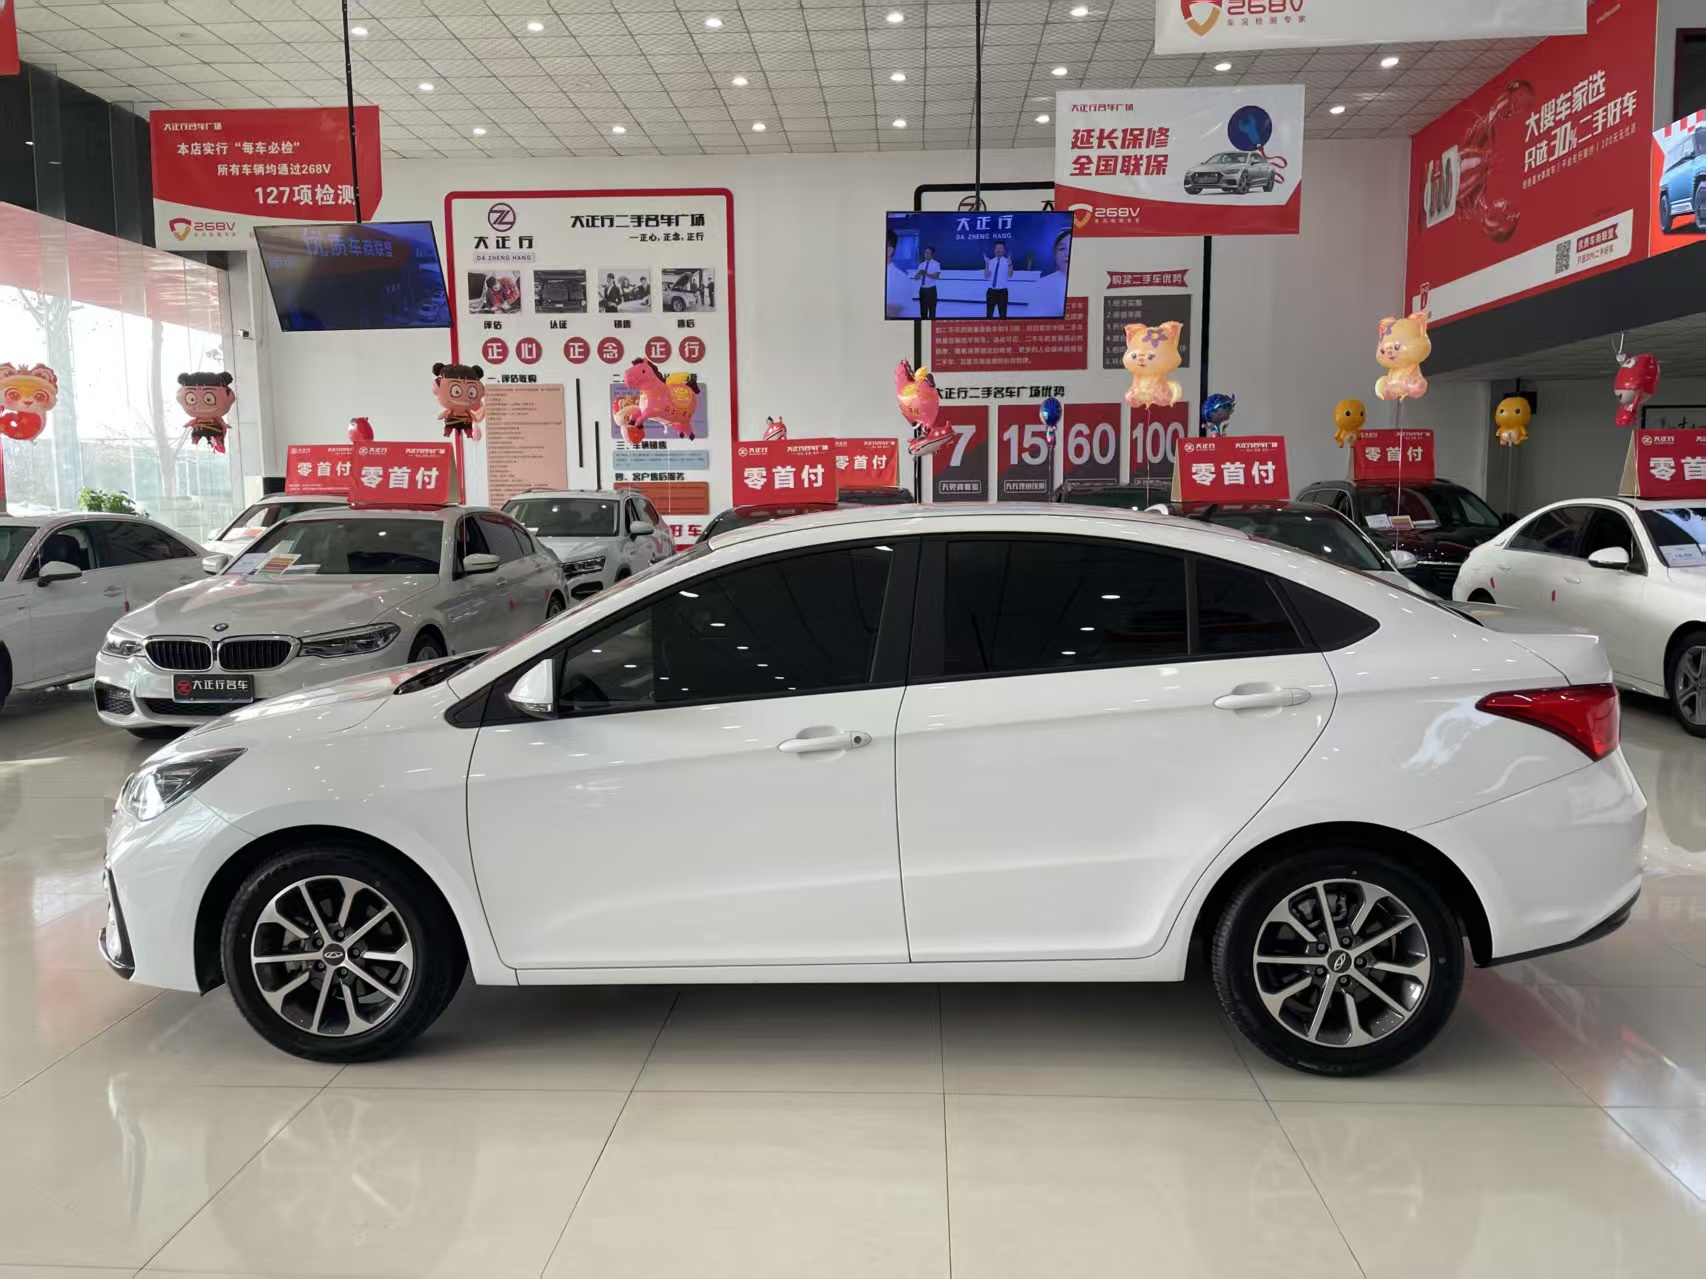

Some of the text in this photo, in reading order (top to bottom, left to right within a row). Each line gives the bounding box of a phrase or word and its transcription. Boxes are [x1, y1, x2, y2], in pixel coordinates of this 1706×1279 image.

[1227, 0, 1304, 15] 268V
[1525, 70, 1606, 143] 大搜车家选
[1071, 127, 1170, 151] 延长保修
[177, 142, 229, 156] 本店实行
[217, 163, 331, 177] 所有车辆均通过268V
[1070, 154, 1169, 177] 全国联保
[254, 184, 357, 205] 127项检测
[1095, 207, 1141, 217] 268V
[194, 222, 236, 231] 268V
[569, 213, 706, 229] 大正行二手名车广场
[956, 215, 1014, 231] 大正行
[473, 236, 534, 250] 大正行
[483, 319, 696, 330] 评估 认证 销售 售后
[952, 421, 1185, 467] 7 15 60 100
[1365, 446, 1423, 462] 零首付
[297, 462, 351, 477] 零首付
[836, 455, 888, 470] 零首付
[360, 466, 440, 490] 零首付
[744, 464, 825, 490] 零首付
[1192, 461, 1276, 485] 零首付
[192, 680, 249, 690] 大正行名车
